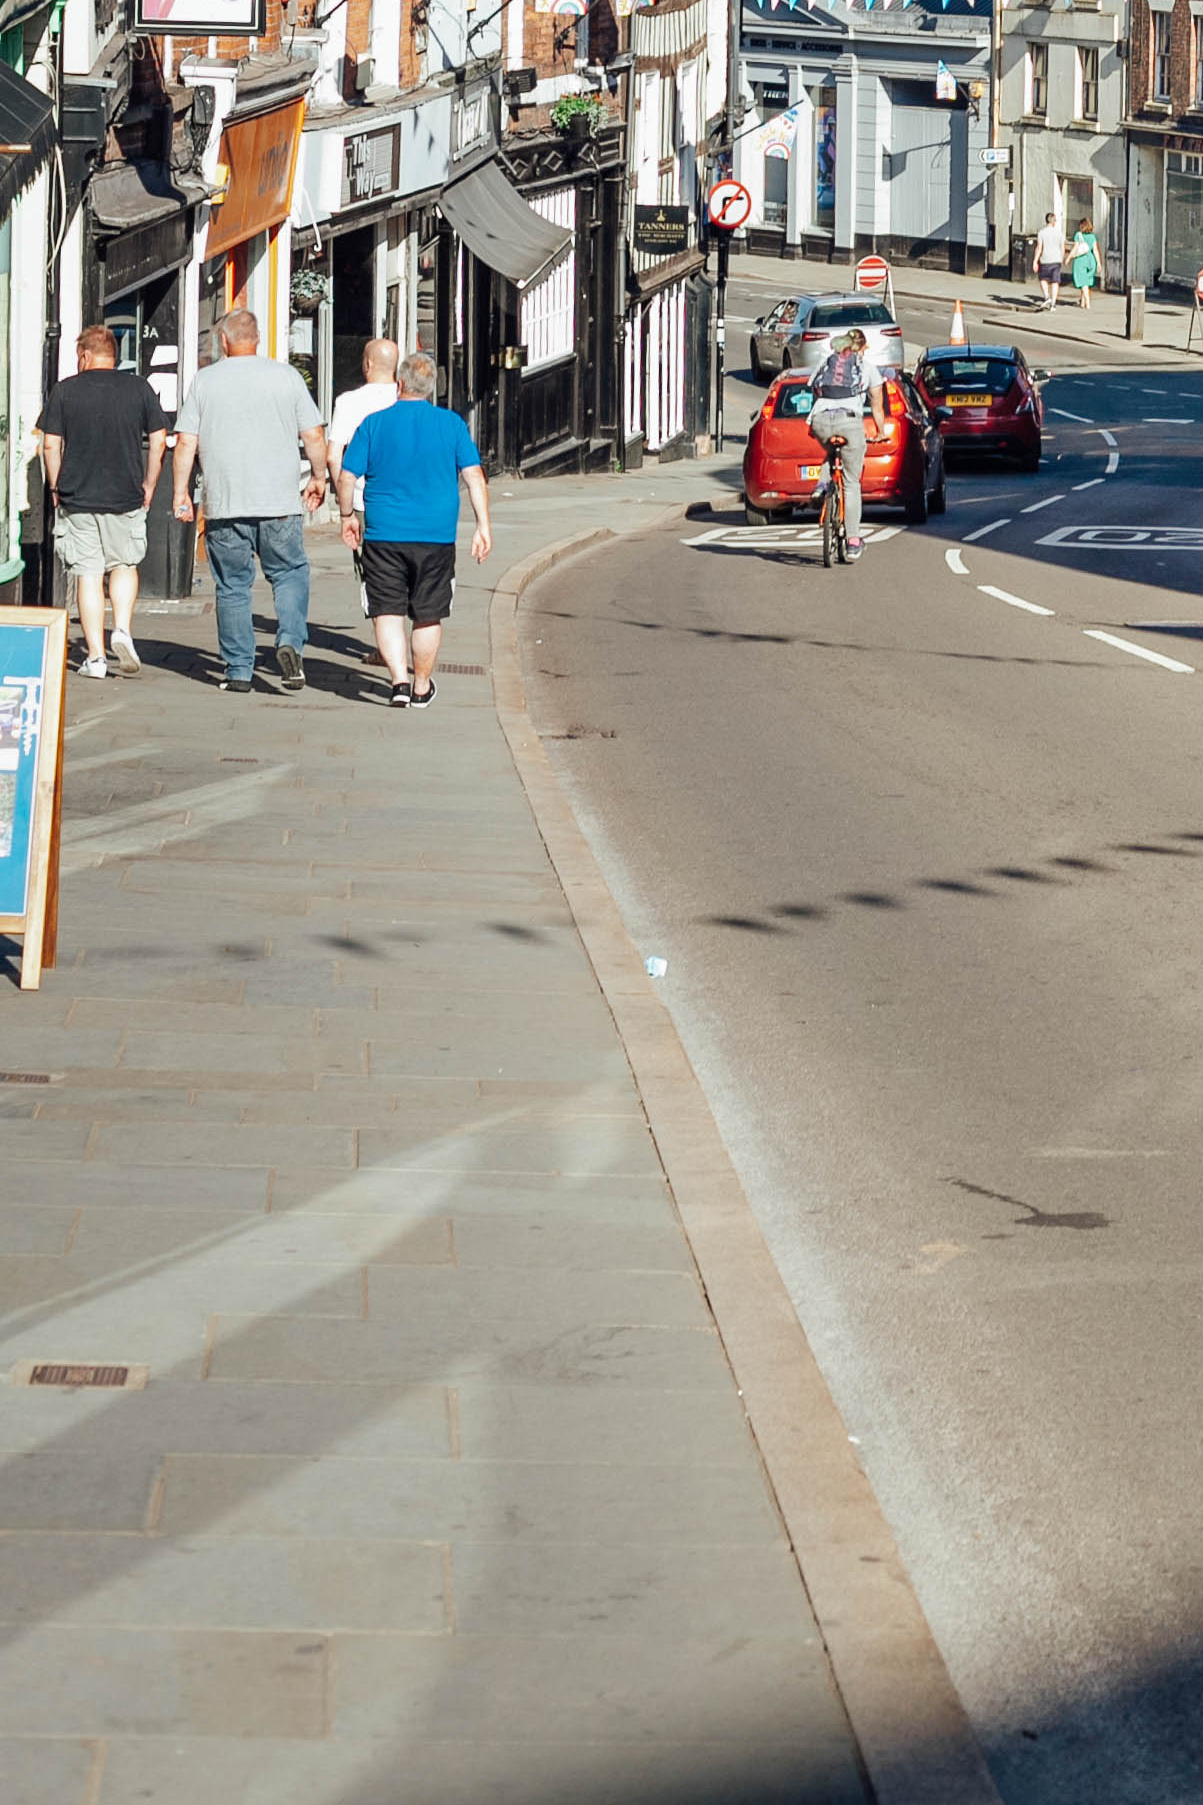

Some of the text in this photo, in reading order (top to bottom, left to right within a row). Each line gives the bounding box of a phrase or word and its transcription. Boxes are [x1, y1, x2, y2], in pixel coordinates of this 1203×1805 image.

[352, 133, 371, 167] This
[356, 166, 376, 199] Way
[638, 222, 685, 231] TANNERS
